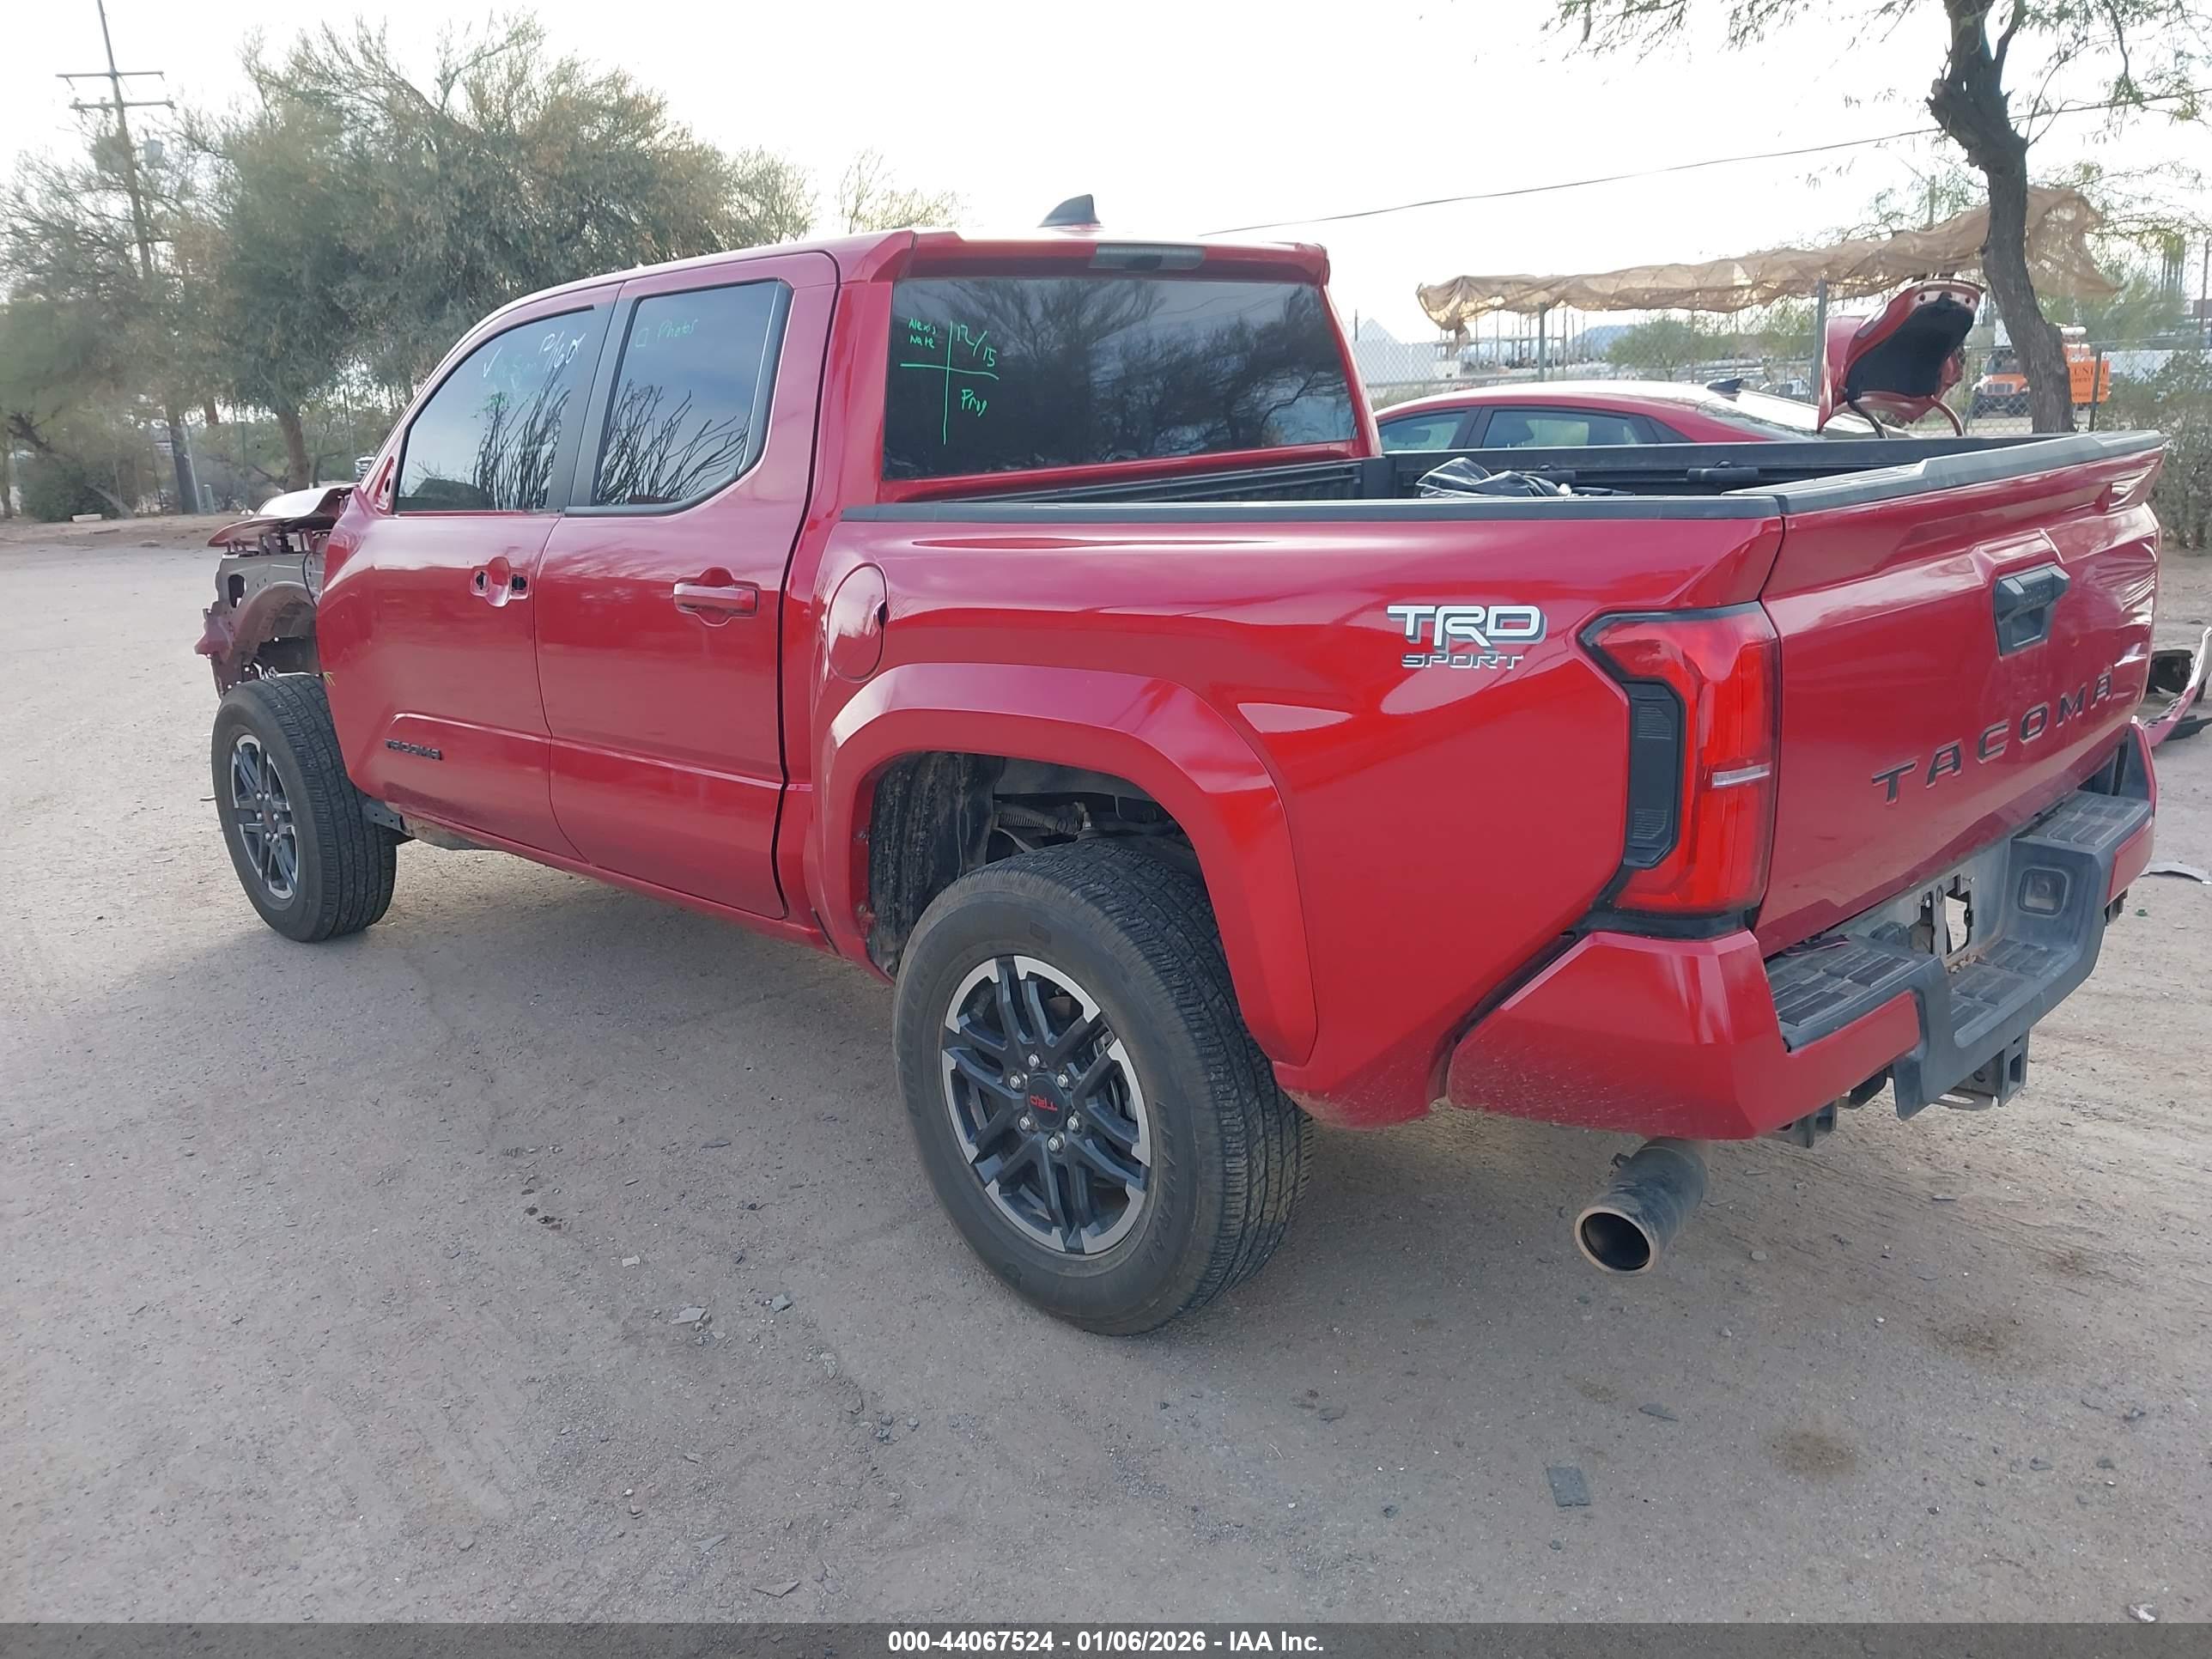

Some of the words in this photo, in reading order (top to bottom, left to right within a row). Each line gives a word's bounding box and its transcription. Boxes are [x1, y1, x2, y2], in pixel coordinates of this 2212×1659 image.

[1387, 605, 1547, 651] TRD
[1401, 653, 1525, 670] SPORT
[1871, 671, 2116, 807] TACOMA
